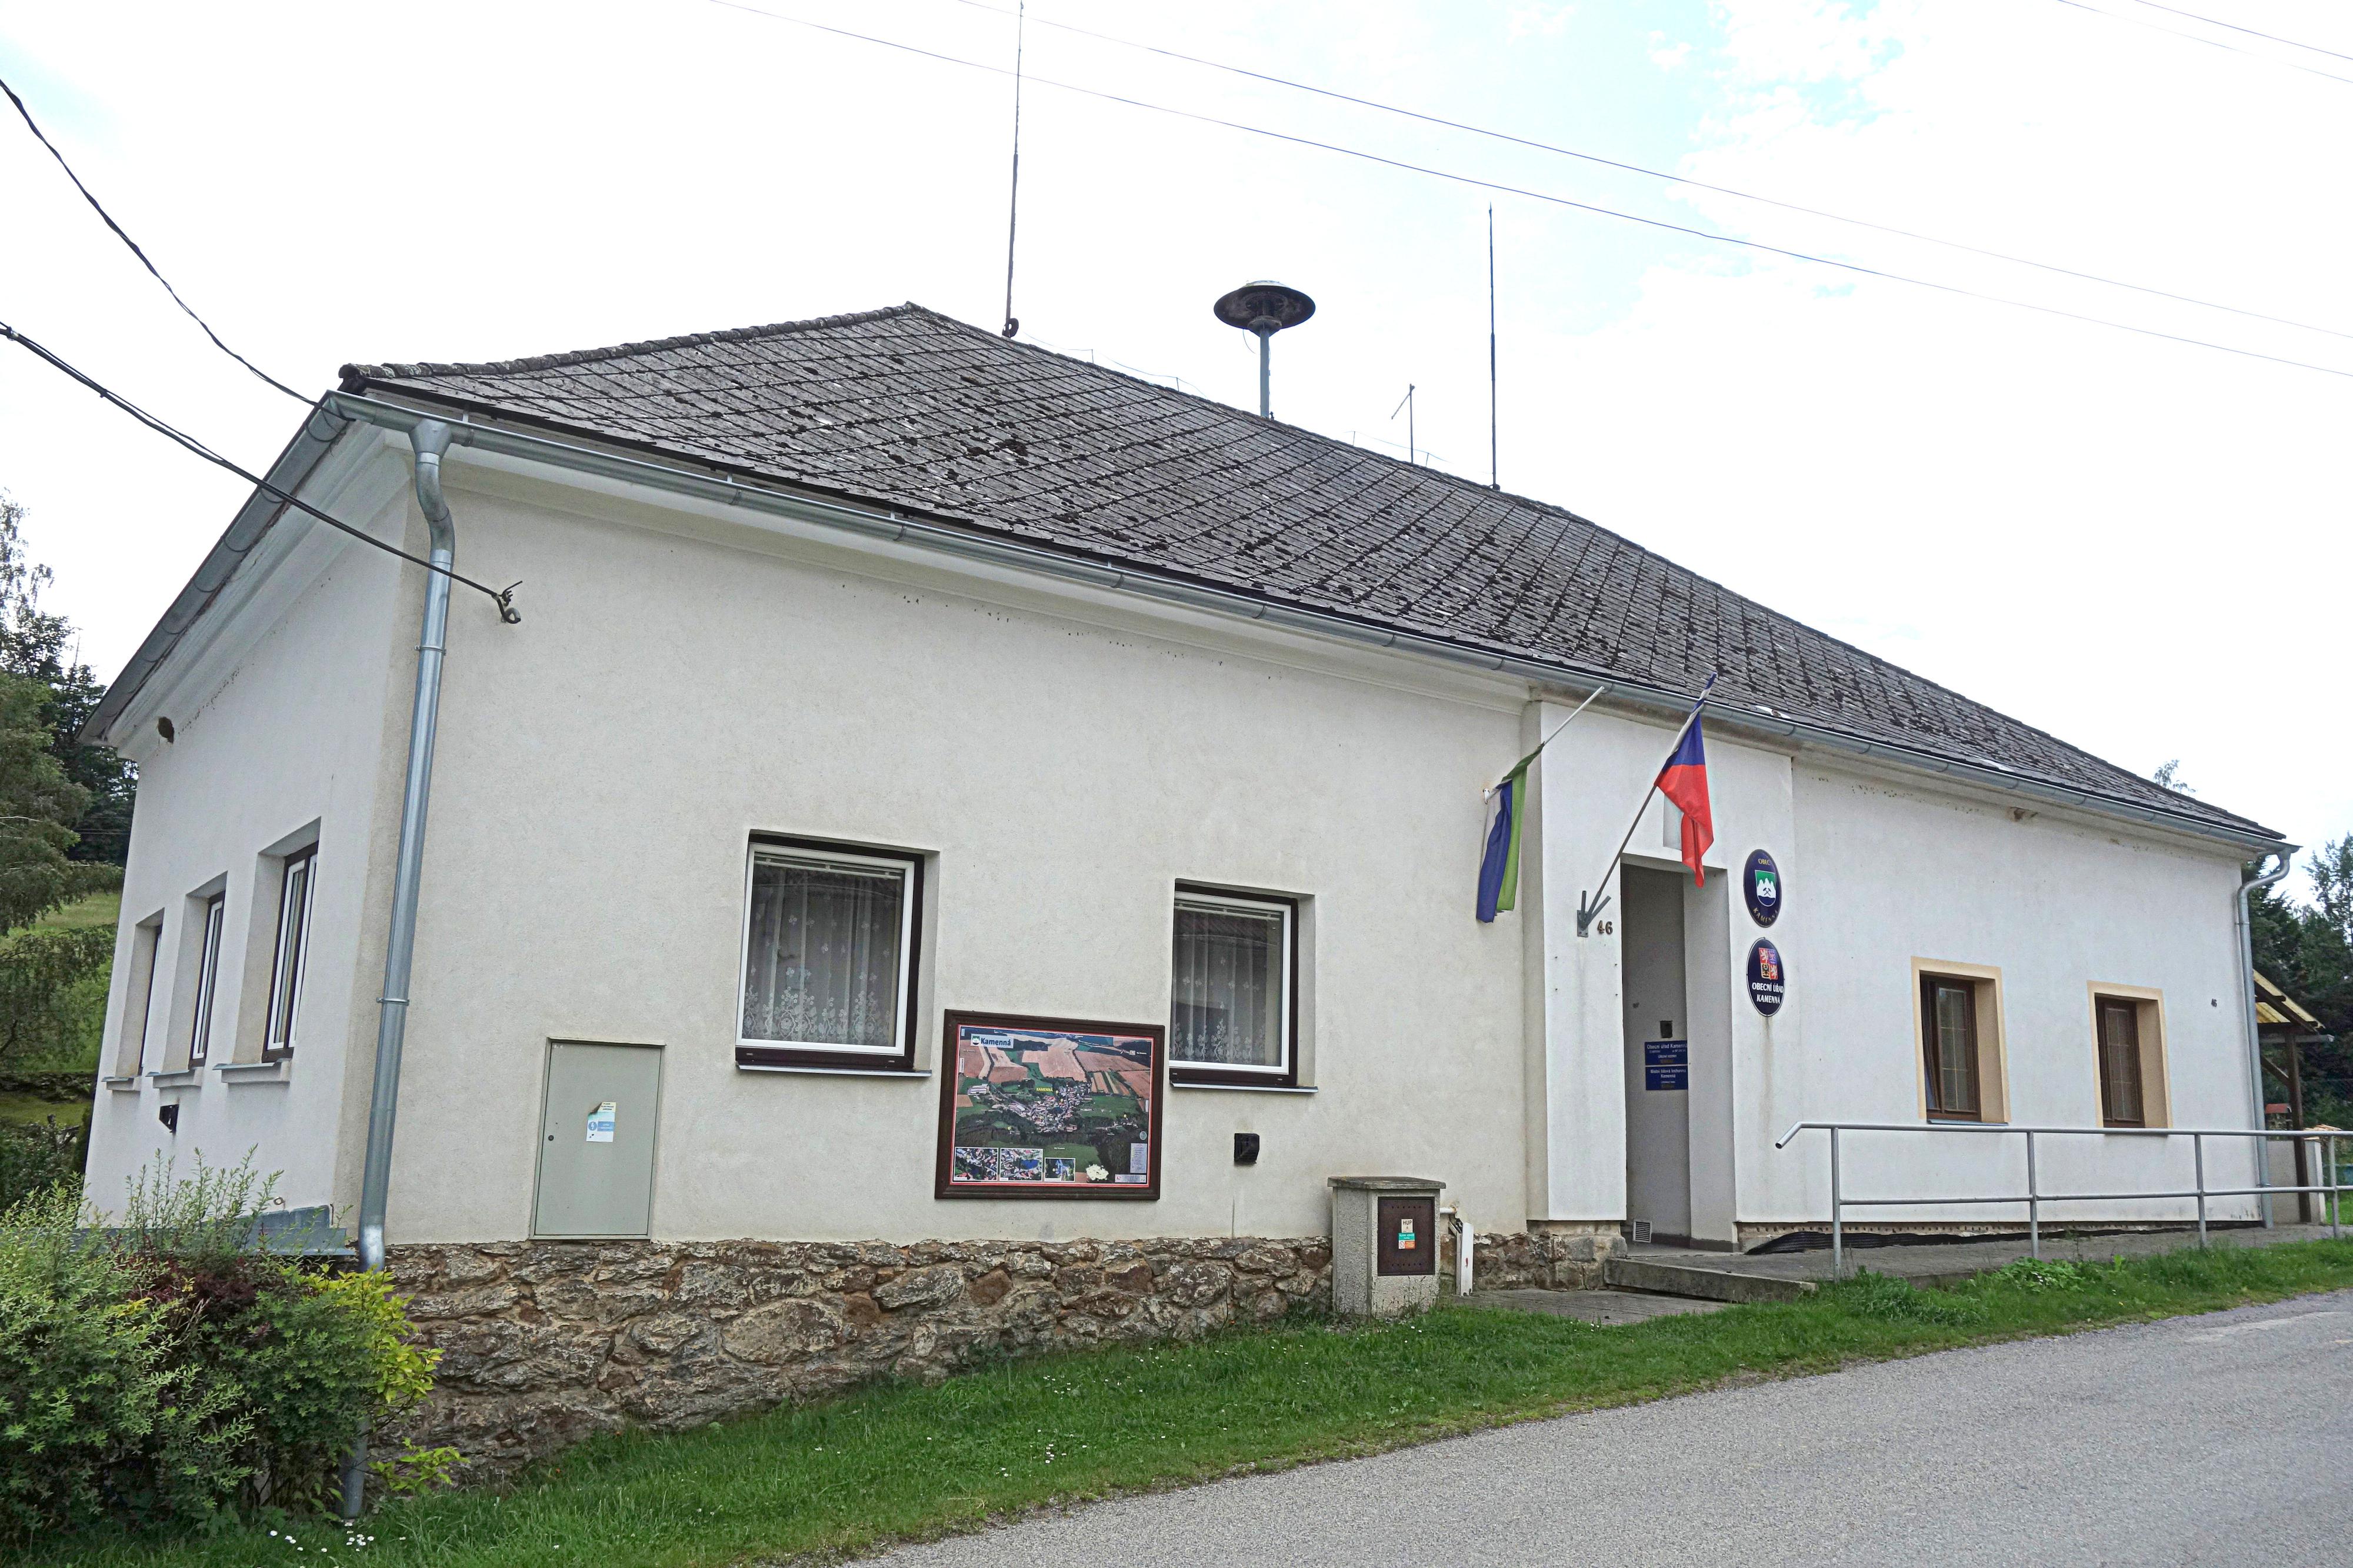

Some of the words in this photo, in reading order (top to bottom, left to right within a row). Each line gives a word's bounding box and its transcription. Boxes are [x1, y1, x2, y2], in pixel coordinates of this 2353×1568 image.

[1597, 920, 1613, 935] 46
[1752, 982, 1772, 992] OBECNÍ
[1772, 983, 1784, 993] ÚŘAD
[1757, 994, 1780, 1004] KAMENNÁ
[981, 1037, 1011, 1046] Kamenná
